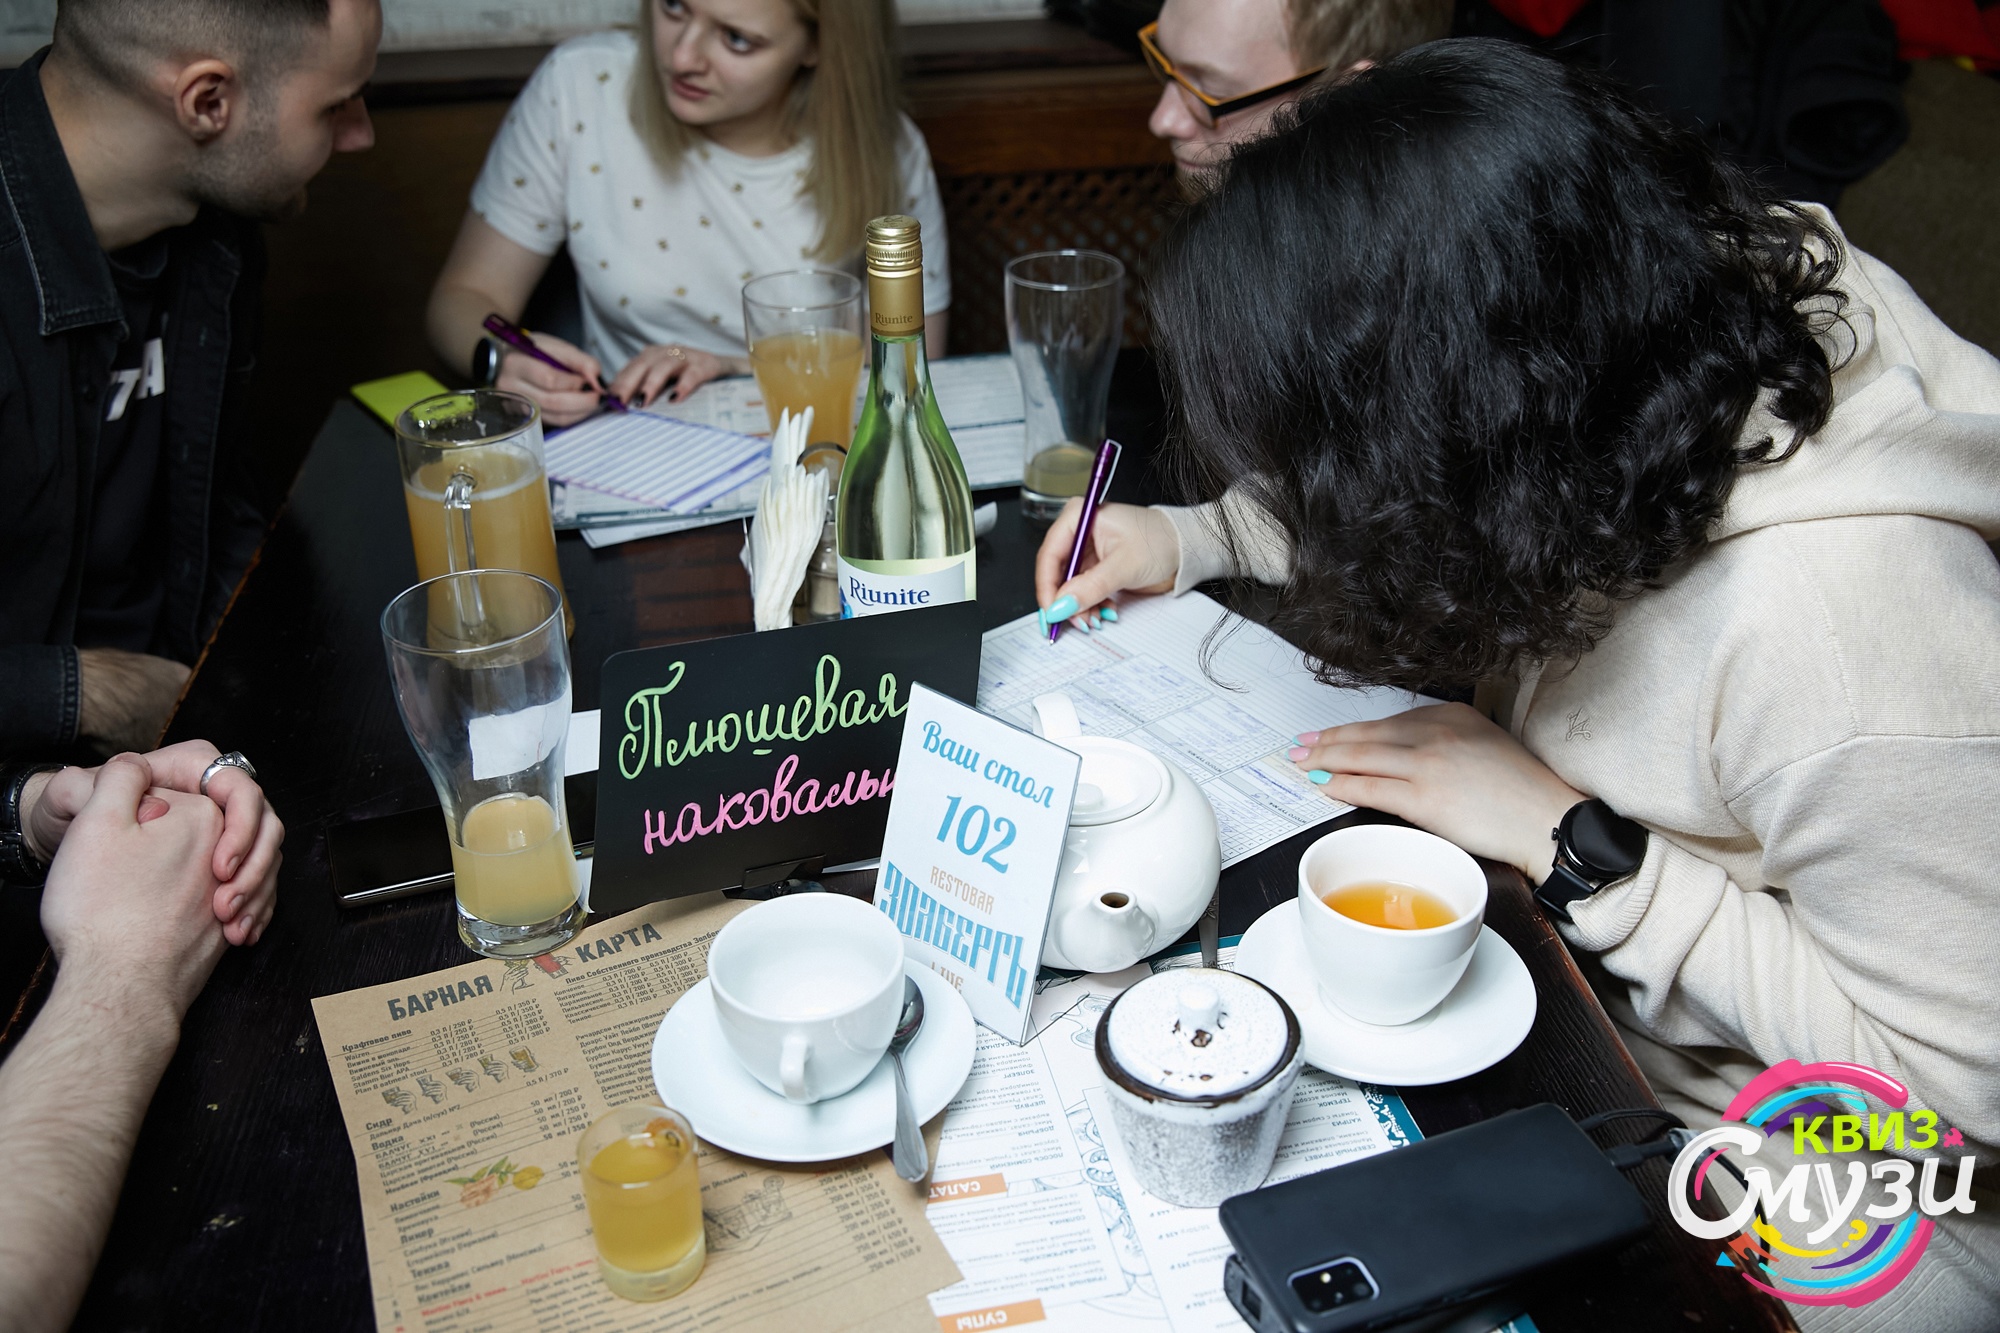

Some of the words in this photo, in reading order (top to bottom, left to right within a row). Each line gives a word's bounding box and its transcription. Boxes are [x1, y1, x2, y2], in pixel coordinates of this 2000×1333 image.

[875, 312, 913, 326] Riunite
[849, 576, 930, 607] Riunite
[619, 654, 907, 780] Плюшевая
[923, 720, 980, 773] Ваш
[984, 759, 1055, 808] стол
[936, 795, 1017, 874] 102
[388, 975, 495, 1021] БАРНАЯ
[574, 922, 663, 964] КАРТА
[565, 974, 586, 984] Пиво
[586, 958, 639, 978] Собственного
[640, 942, 694, 963] производства
[342, 1036, 390, 1054] Крафтовое
[391, 1030, 412, 1039] пиво
[344, 1051, 370, 1061] Waizen
[517, 1000, 531, 1008] 350
[347, 1058, 370, 1068] Вишня
[377, 1046, 411, 1060] шоколаде
[454, 1027, 468, 1035] 250
[349, 1060, 385, 1075] Вишневый
[456, 1033, 470, 1041] 250
[523, 1011, 537, 1019] 350
[351, 1070, 380, 1082] Saldens
[393, 1060, 411, 1069] Hops
[459, 1039, 473, 1047] 280
[525, 1017, 538, 1025] 380
[353, 1078, 379, 1089] Stamm
[379, 1072, 394, 1080] Bier
[396, 1066, 410, 1074] APA
[439, 1053, 450, 1061] 0,3
[462, 1045, 476, 1053] 280
[528, 1023, 542, 1031] 380
[355, 1087, 372, 1095] Plan
[380, 1074, 408, 1087] oatmeal
[410, 1068, 428, 1078] stout
[442, 1060, 453, 1068] 0,3
[465, 1051, 479, 1059] 280
[531, 1029, 545, 1037] 380
[1014, 1100, 1046, 1110] ШЕРВУД
[1317, 1098, 1351, 1108] ТЕРЕМОК
[366, 1118, 393, 1131] Сидр
[1331, 1118, 1361, 1127] КАПРИЗ
[371, 1136, 404, 1151] Водка
[1335, 1144, 1376, 1156] СЕВЕРНЫЙ
[1304, 1152, 1334, 1162] ПРИВЕТ
[390, 1191, 440, 1212] Настойки
[400, 1228, 434, 1244] Ликер
[411, 1262, 450, 1278] Текила
[956, 1310, 1008, 1331] СУПЫ
